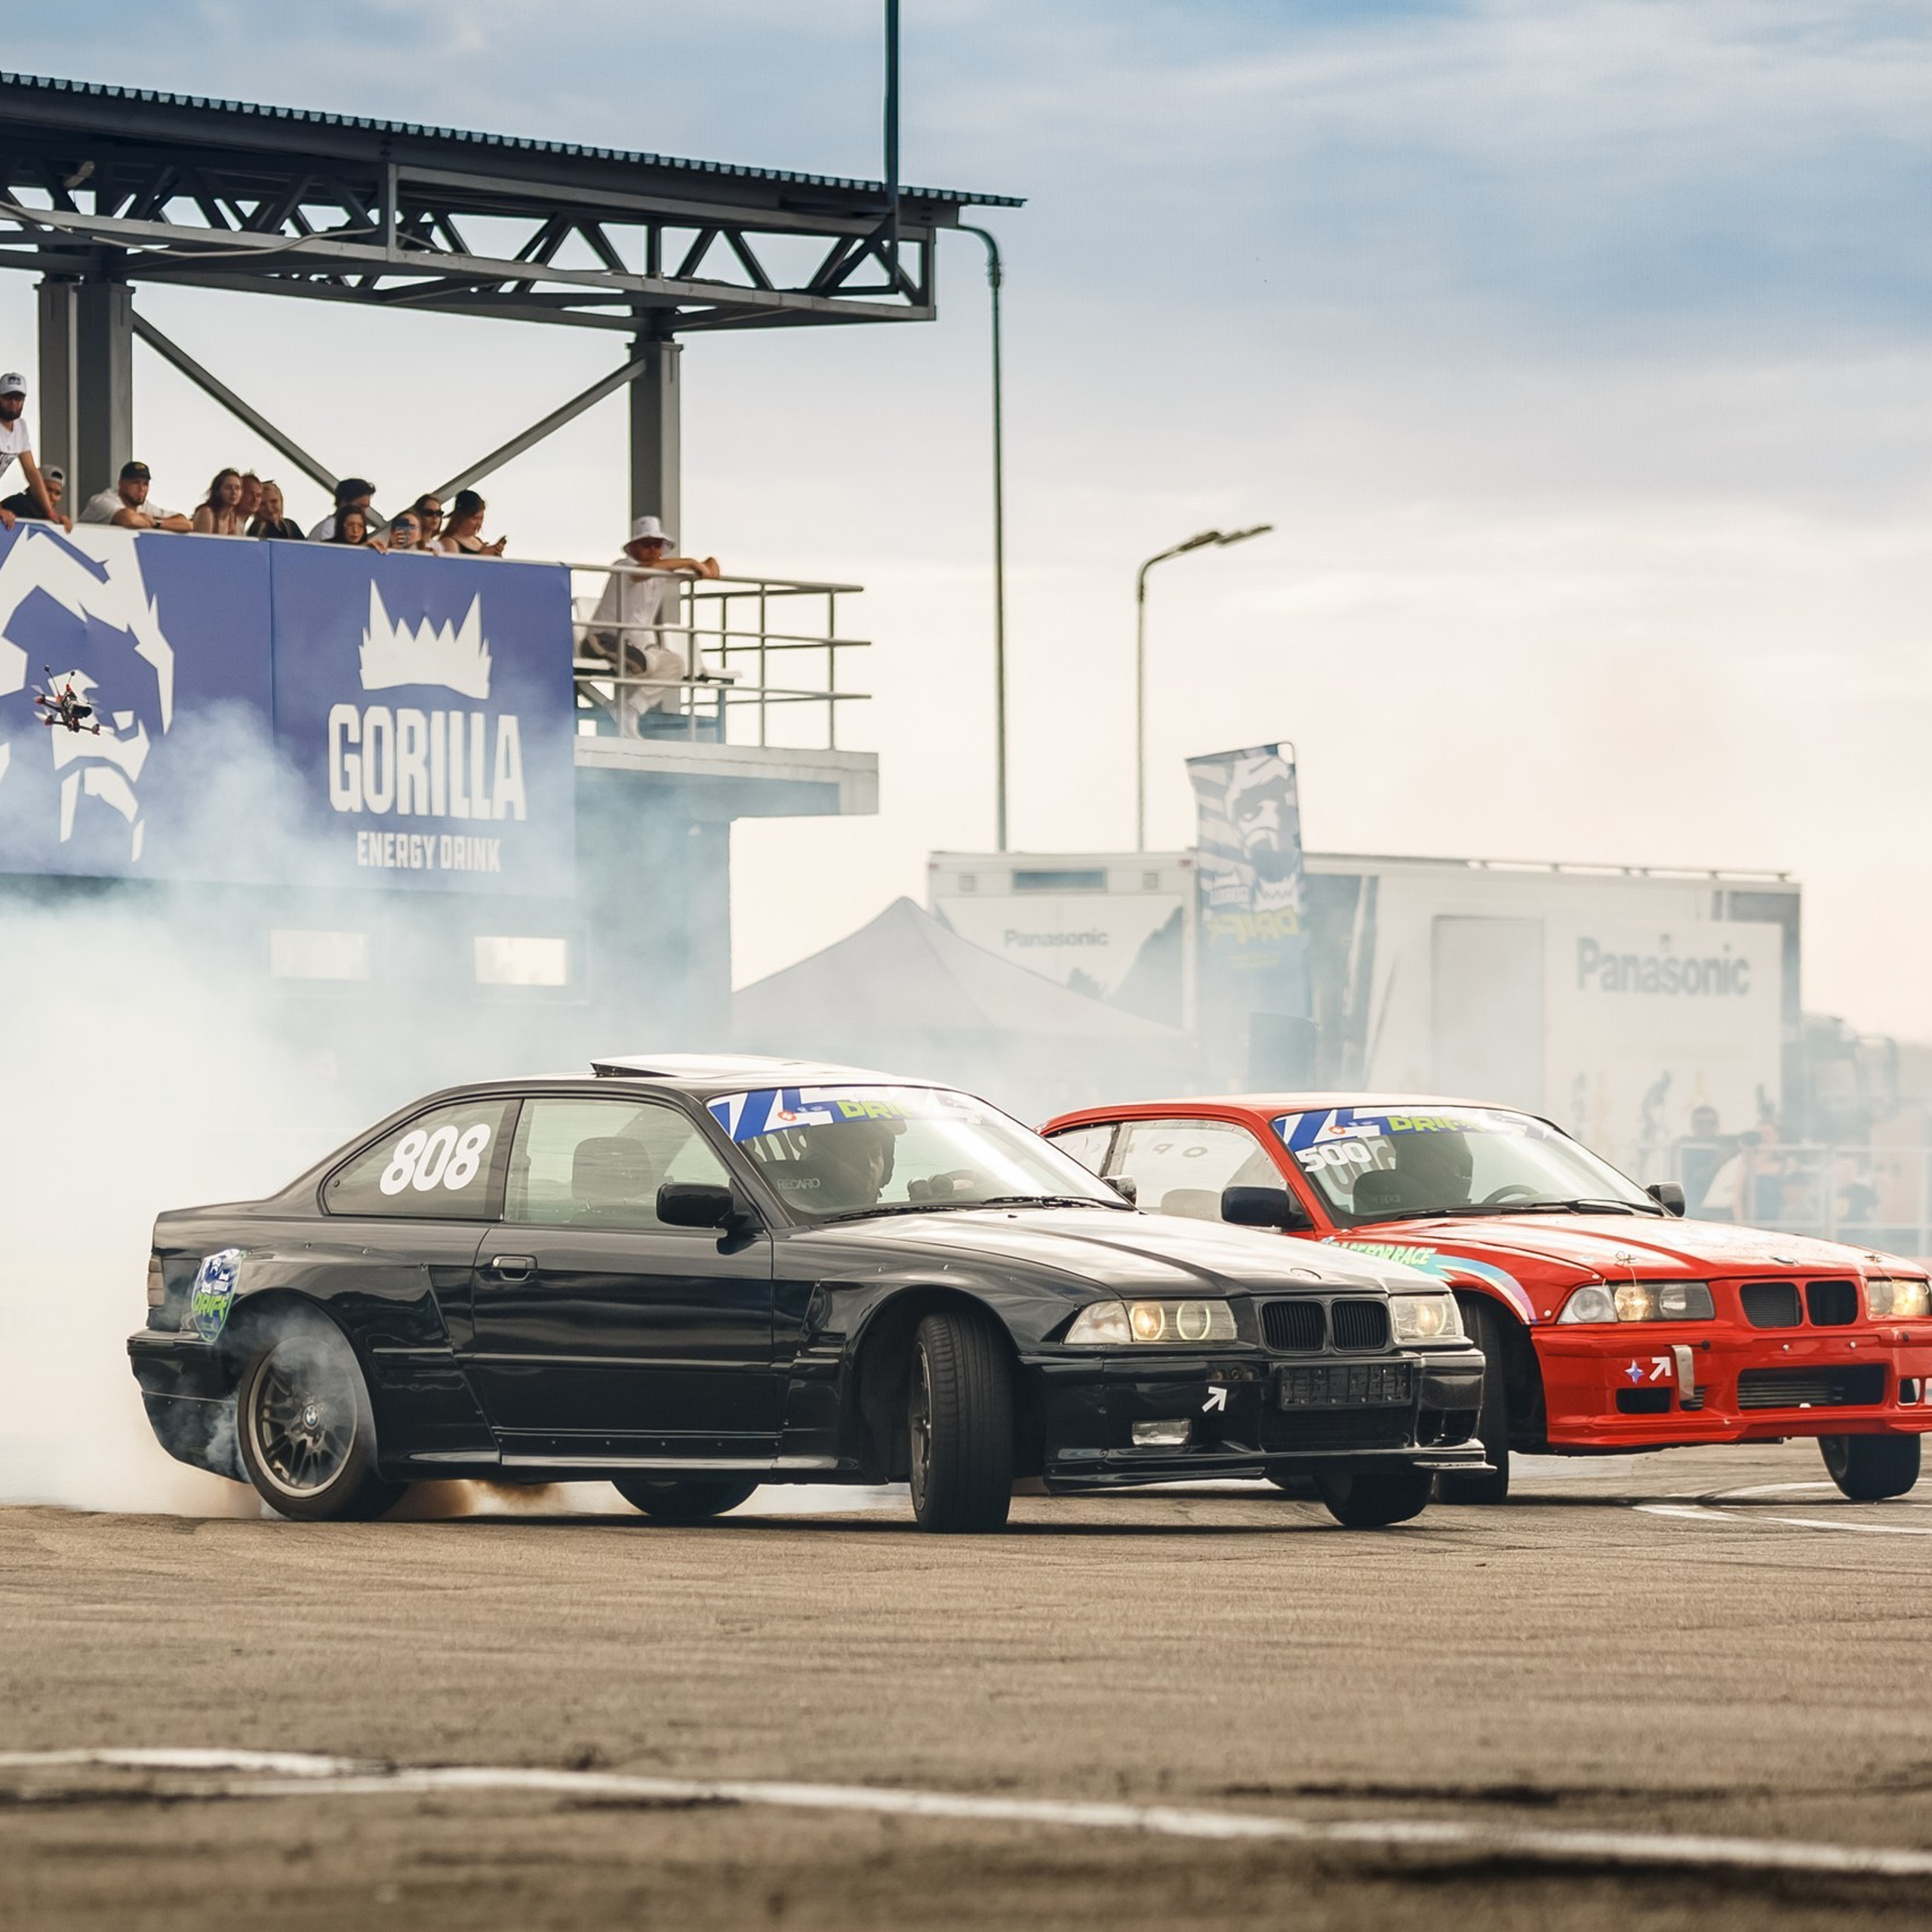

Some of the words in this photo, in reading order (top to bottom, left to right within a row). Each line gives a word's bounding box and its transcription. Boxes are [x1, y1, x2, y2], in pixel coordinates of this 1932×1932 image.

[328, 703, 527, 820] GORILLA
[357, 832, 437, 869] ENERGY
[440, 835, 501, 872] DRINK
[1004, 928, 1109, 948] Panasonic
[1577, 937, 1751, 996] Panasonic
[380, 1124, 491, 1195] 808
[1295, 1142, 1372, 1173] 500
[777, 1177, 820, 1190] RECARO
[195, 1290, 228, 1321] DRIFT
